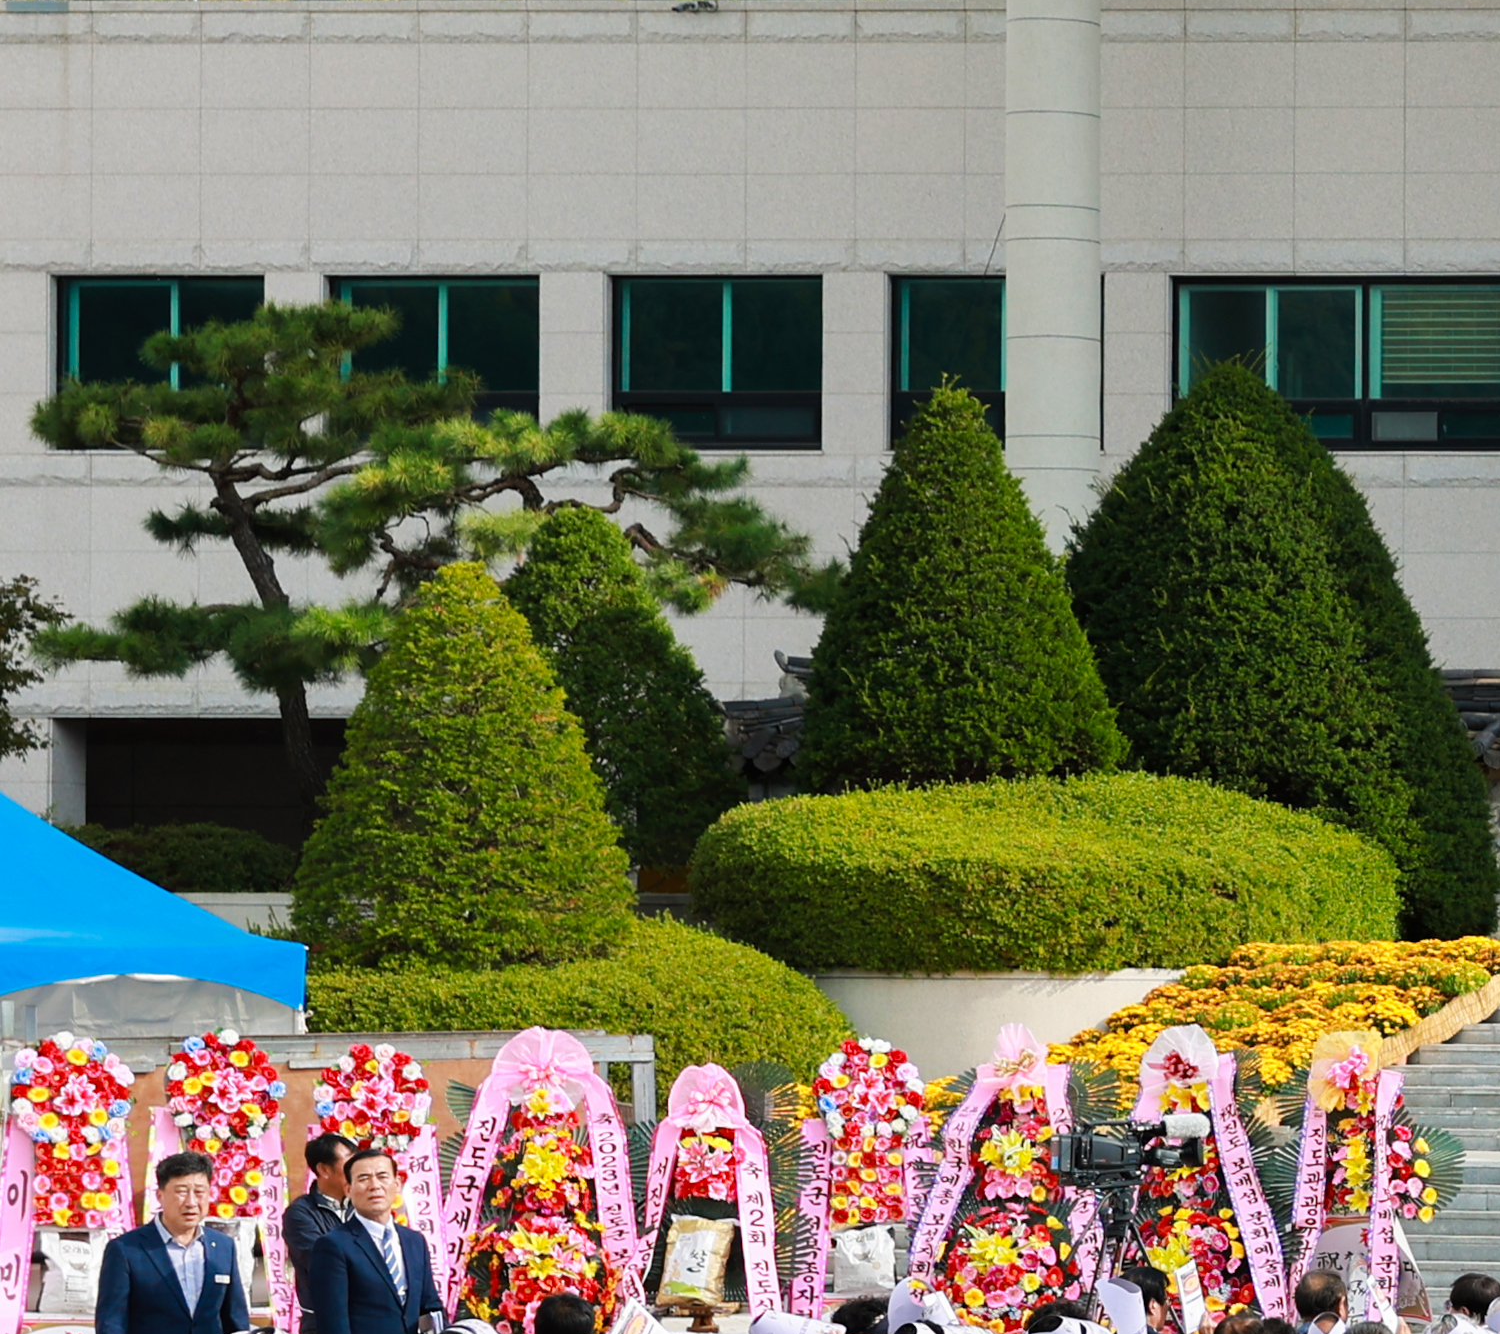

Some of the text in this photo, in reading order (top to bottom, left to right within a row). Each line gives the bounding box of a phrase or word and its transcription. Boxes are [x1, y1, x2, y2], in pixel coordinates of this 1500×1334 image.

[409, 1156, 433, 1174] 祝
[598, 1131, 621, 1196] 2023년
[741, 1161, 763, 1180] 축
[1229, 1155, 1260, 1203] 보배섬
[603, 1203, 632, 1242] 진도군
[745, 1191, 768, 1248] 제2회
[911, 1213, 947, 1278] 보성지회
[1244, 1208, 1285, 1291] 문화예술제
